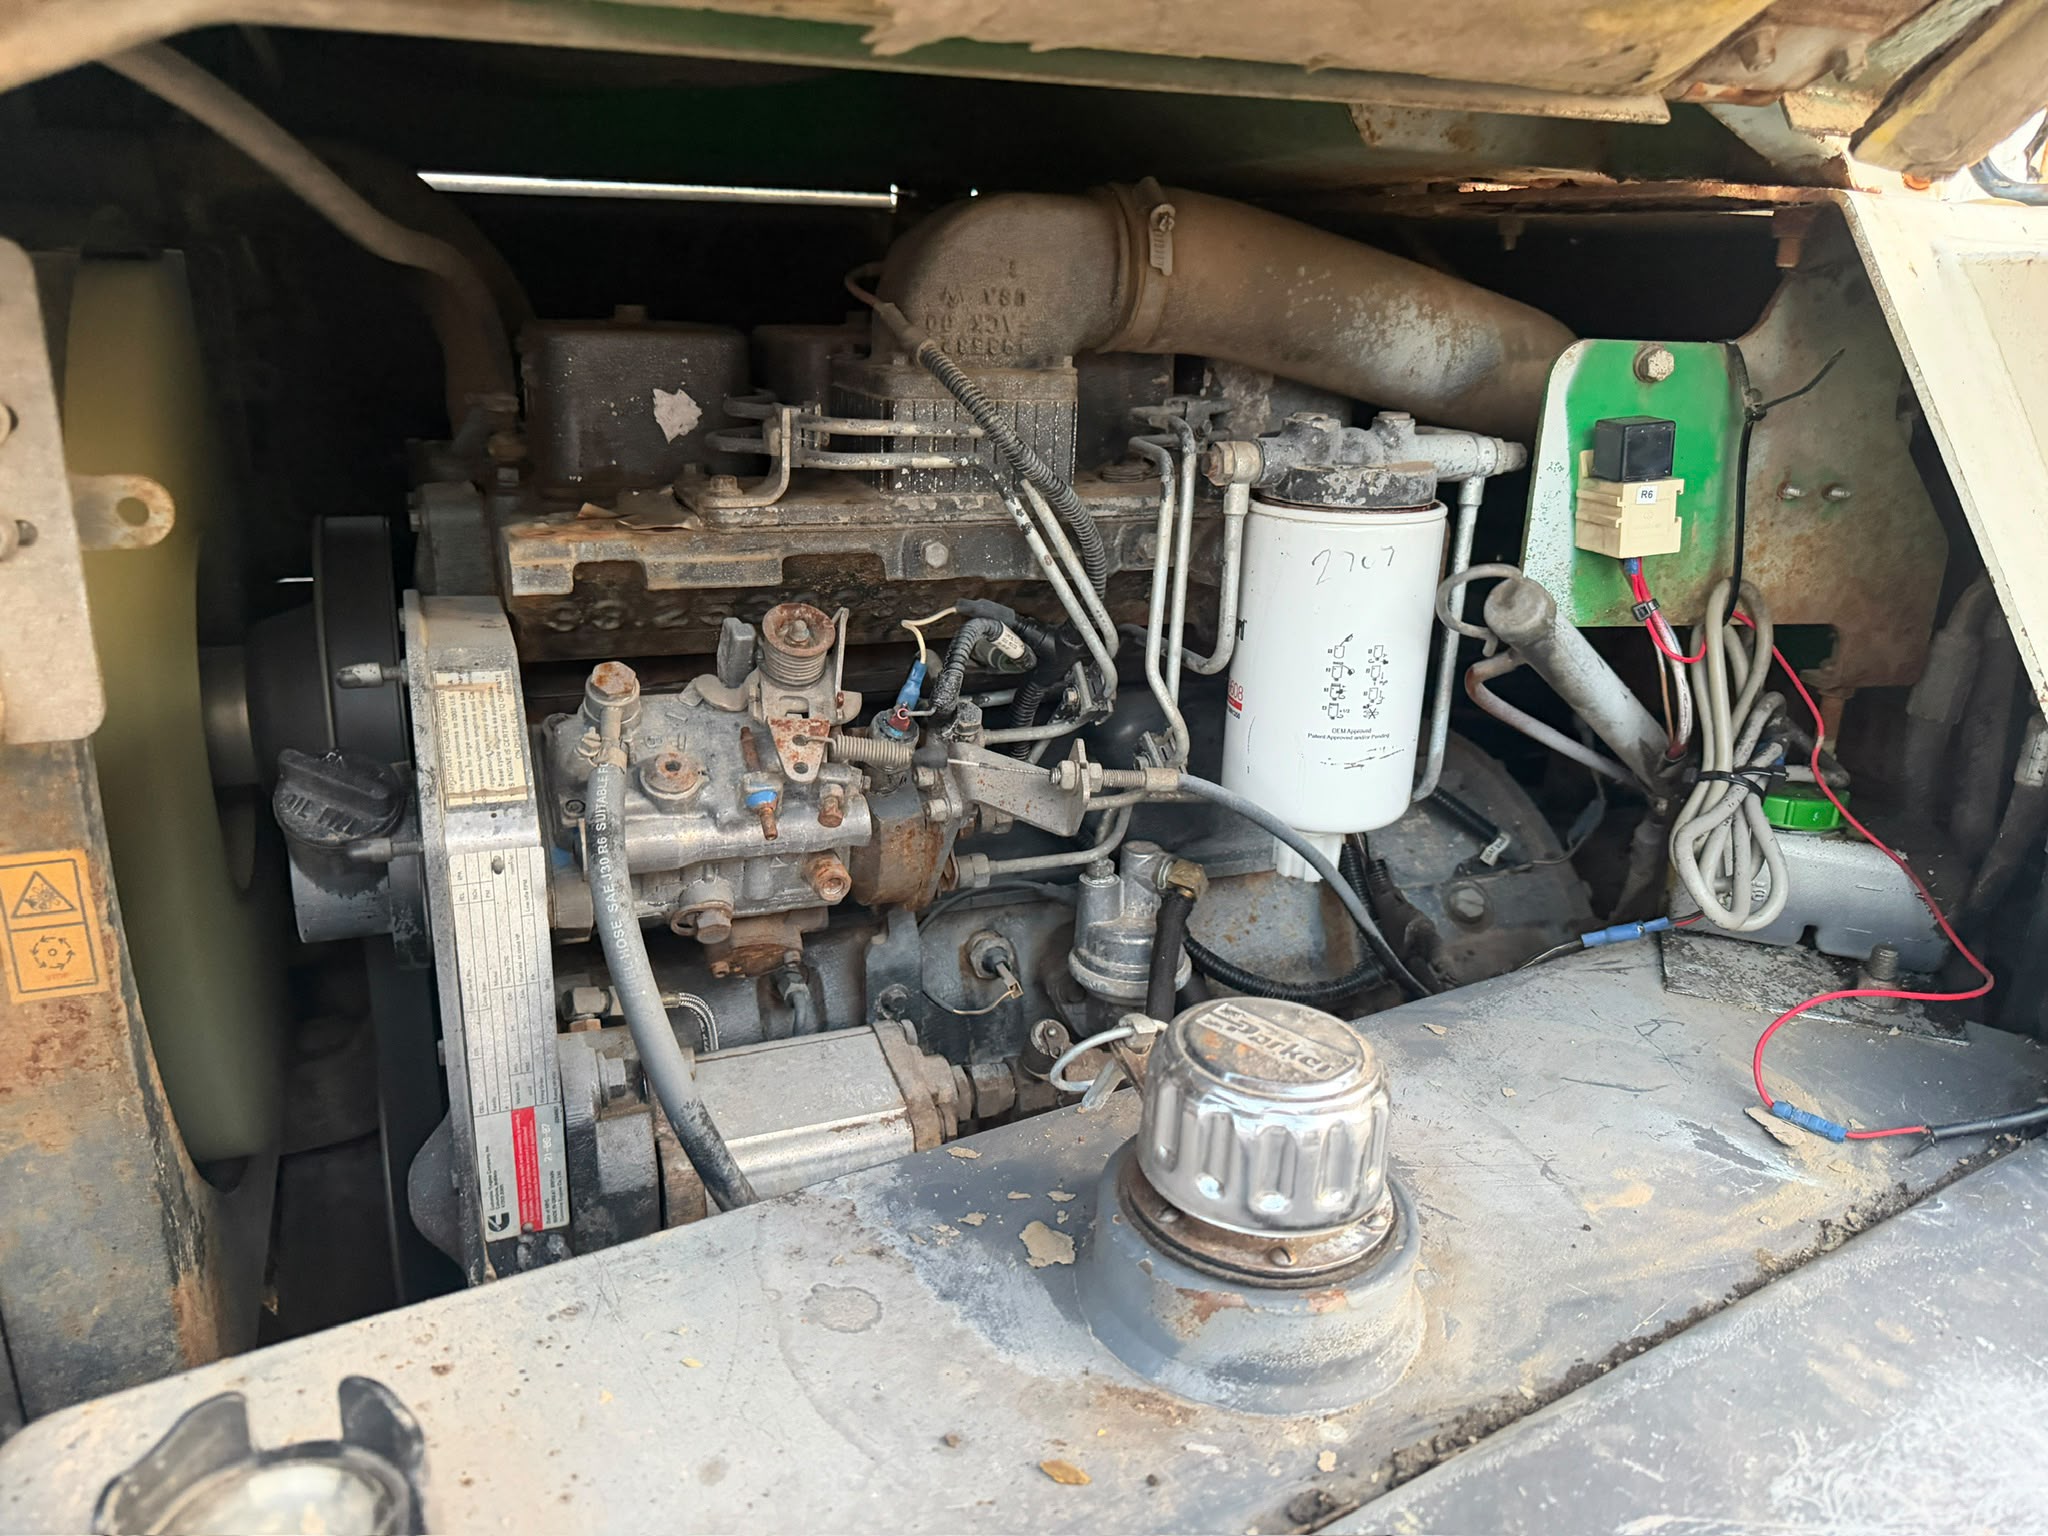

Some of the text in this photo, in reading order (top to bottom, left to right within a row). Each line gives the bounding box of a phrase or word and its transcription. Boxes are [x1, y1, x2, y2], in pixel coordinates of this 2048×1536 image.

[1640, 490, 1653, 498] R6
[1346, 728, 1372, 736] Approved
[595, 775, 609, 832] SUITABLE
[597, 836, 609, 854] R6
[599, 857, 613, 880] J30
[604, 884, 620, 913] SAE
[610, 920, 631, 960] HOSE
[1228, 1016, 1333, 1074] Parker
